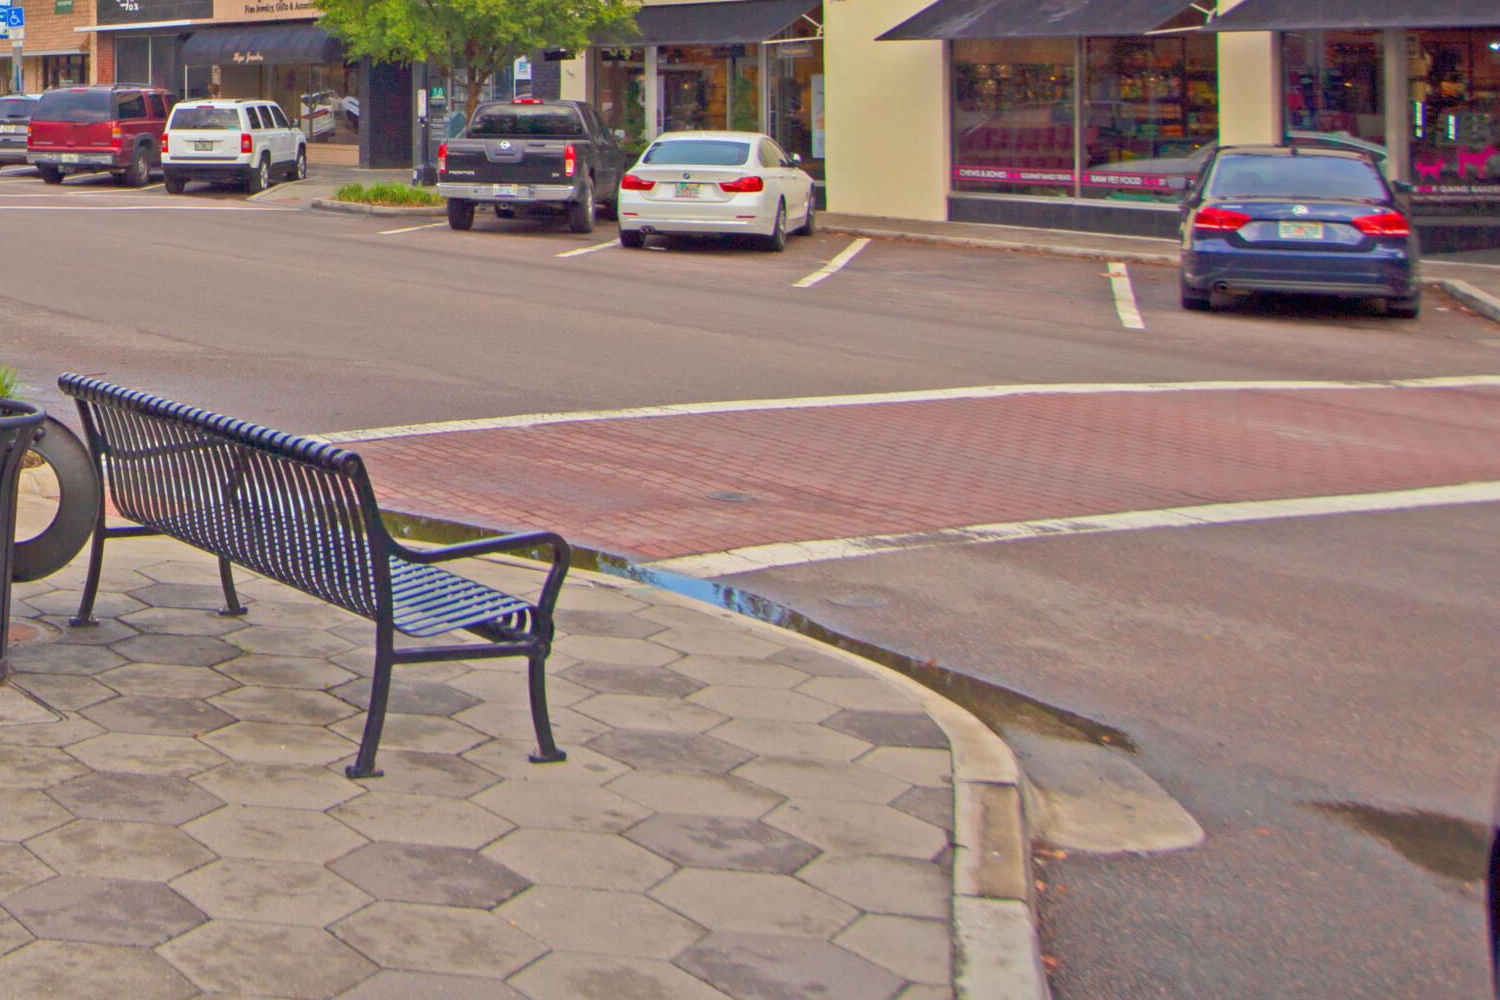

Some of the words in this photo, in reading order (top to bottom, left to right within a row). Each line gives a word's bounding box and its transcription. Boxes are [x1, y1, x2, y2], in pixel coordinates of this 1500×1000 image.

[1091, 174, 1106, 183] RAW
[1108, 175, 1118, 184] PET
[1119, 176, 1142, 185] FOOD
